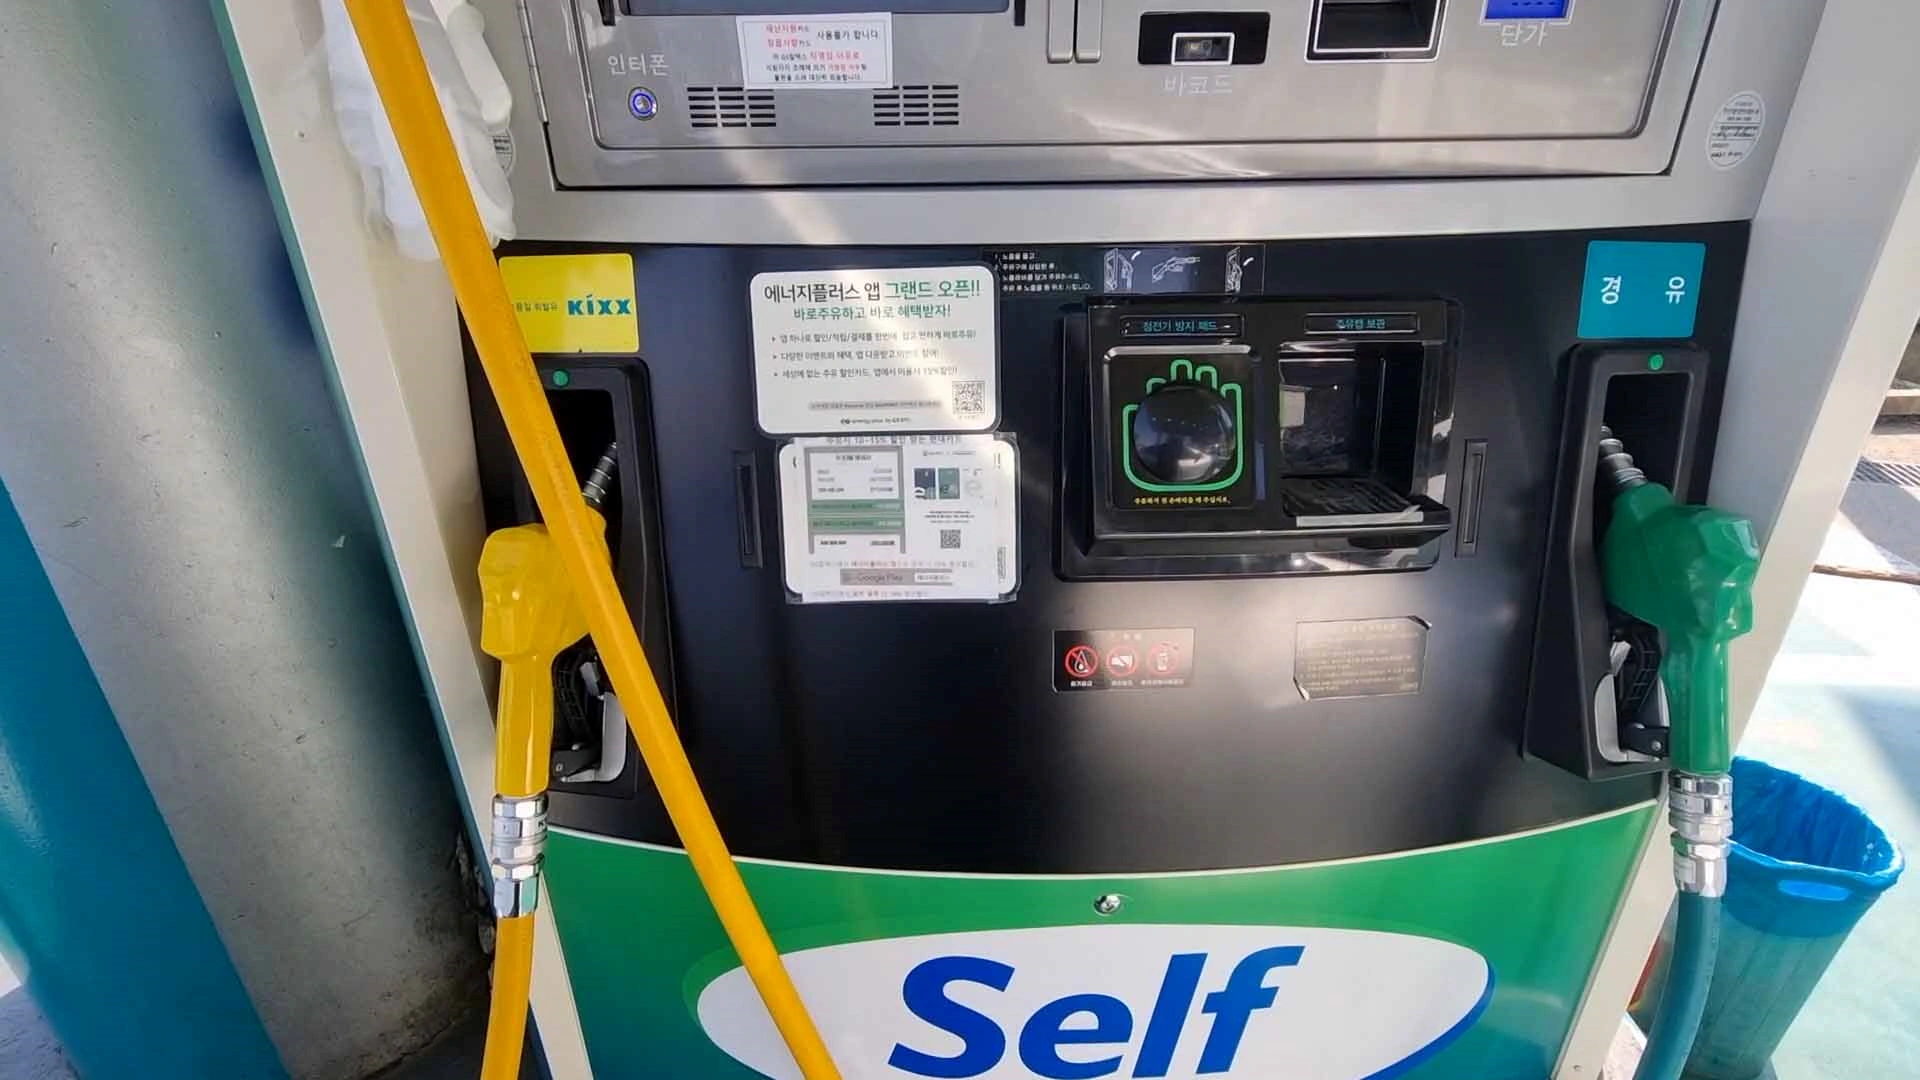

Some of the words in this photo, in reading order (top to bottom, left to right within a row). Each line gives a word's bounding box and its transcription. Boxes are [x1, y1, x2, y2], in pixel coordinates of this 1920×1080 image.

[853, 29, 879, 40] 합니다
[1501, 24, 1547, 47] 단가
[607, 53, 670, 77] 인터폰
[1163, 75, 1234, 96] 바코드
[764, 282, 861, 303] 에너지플러스
[864, 282, 881, 301] 앱
[885, 281, 933, 300] 그랜드
[938, 279, 980, 299] 오픈!!
[793, 306, 866, 321] 바로주유하고
[870, 305, 895, 319] 바로
[897, 304, 952, 318] 혜택받자!
[1176, 320, 1194, 332] 방지
[887, 944, 1306, 1080] Self
